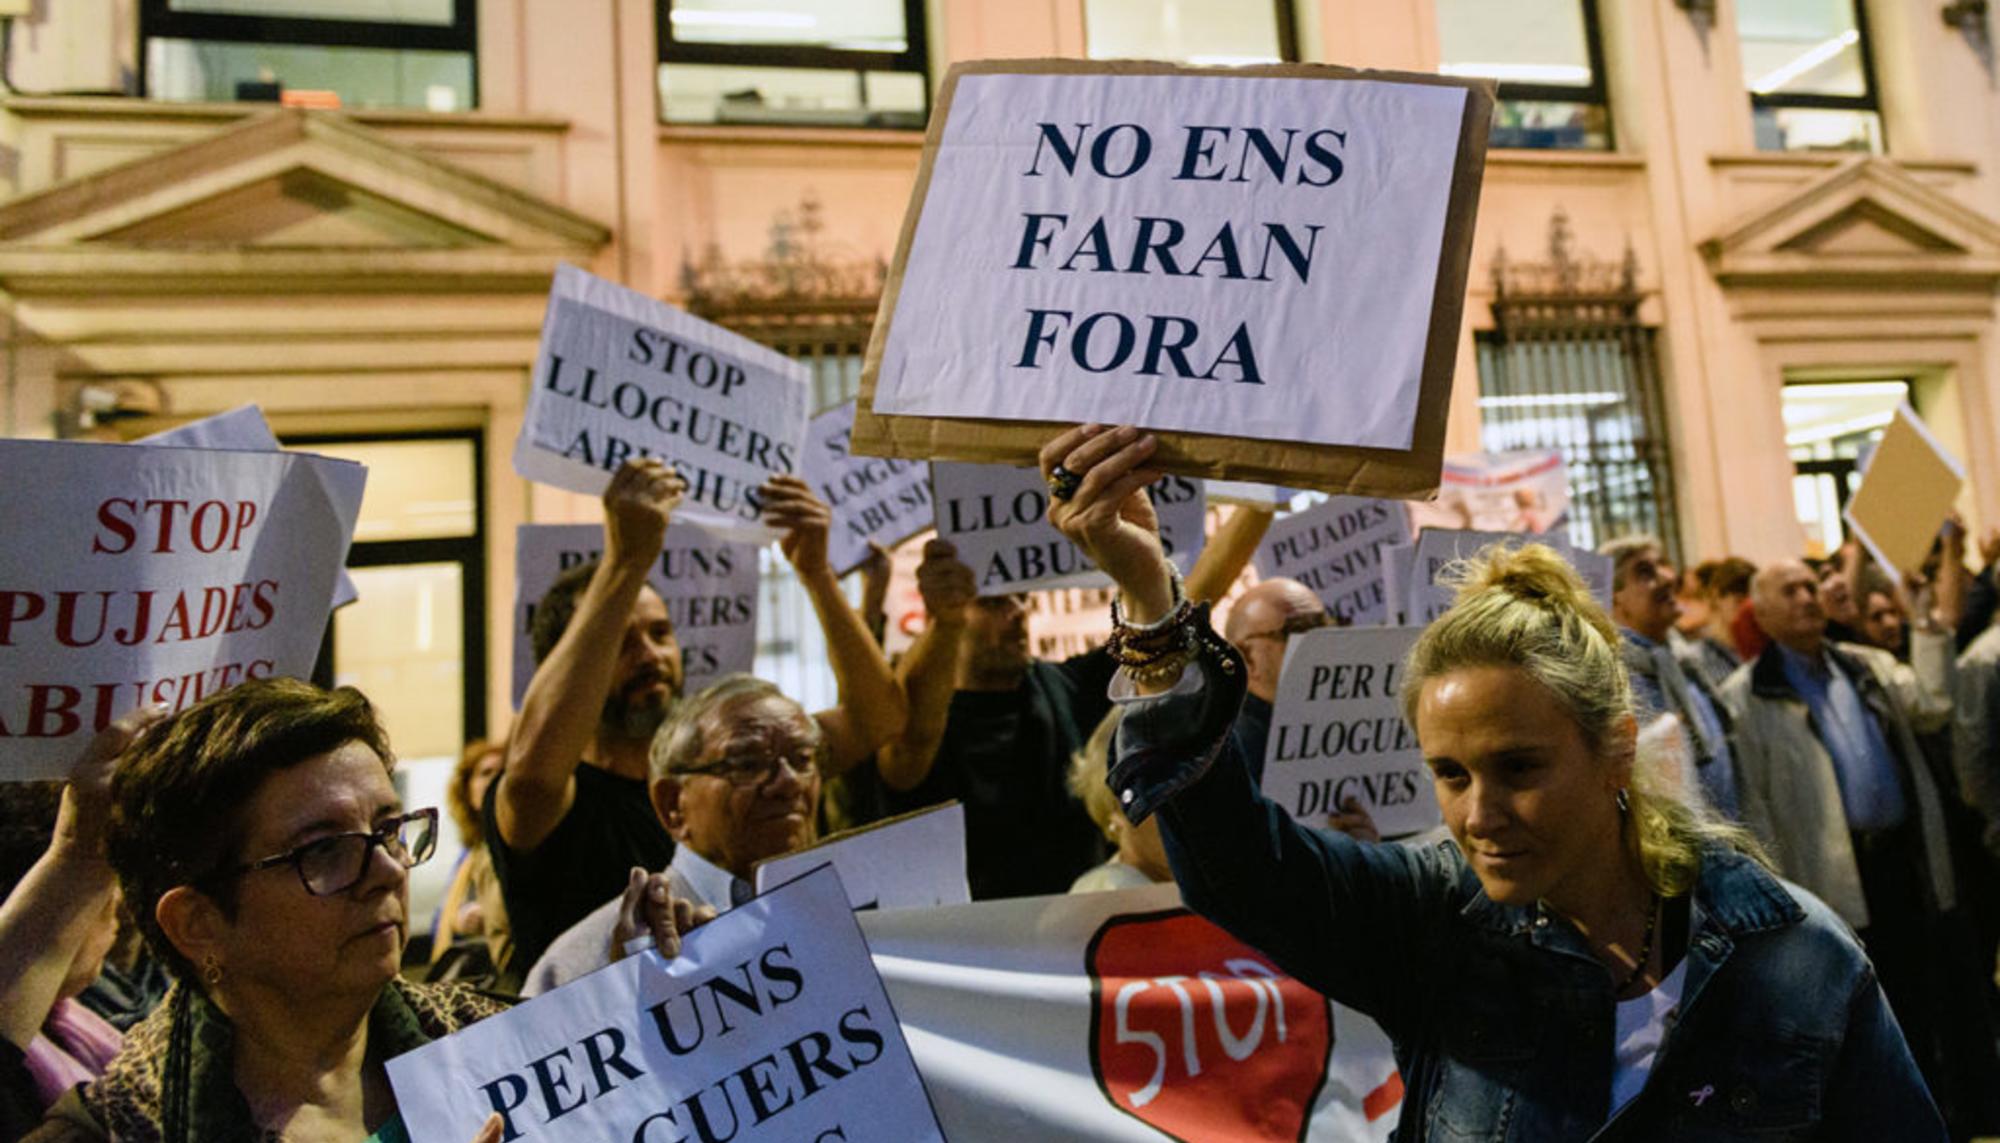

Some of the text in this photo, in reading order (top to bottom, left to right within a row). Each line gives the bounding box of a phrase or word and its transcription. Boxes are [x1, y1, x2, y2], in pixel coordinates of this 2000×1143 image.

[1023, 122, 1347, 187] NO ENS
[1009, 213, 1325, 284] FARAN
[628, 327, 747, 399] STOP
[1012, 308, 1265, 385] FORA
[543, 353, 796, 476] LLOGUERS
[563, 429, 763, 522] ABSIUS
[92, 497, 257, 555] STOP
[1271, 503, 1390, 567] PUJADES
[0, 579, 279, 648] PUJADES
[1305, 663, 1374, 701] PER
[478, 942, 805, 1143] PER UNS
